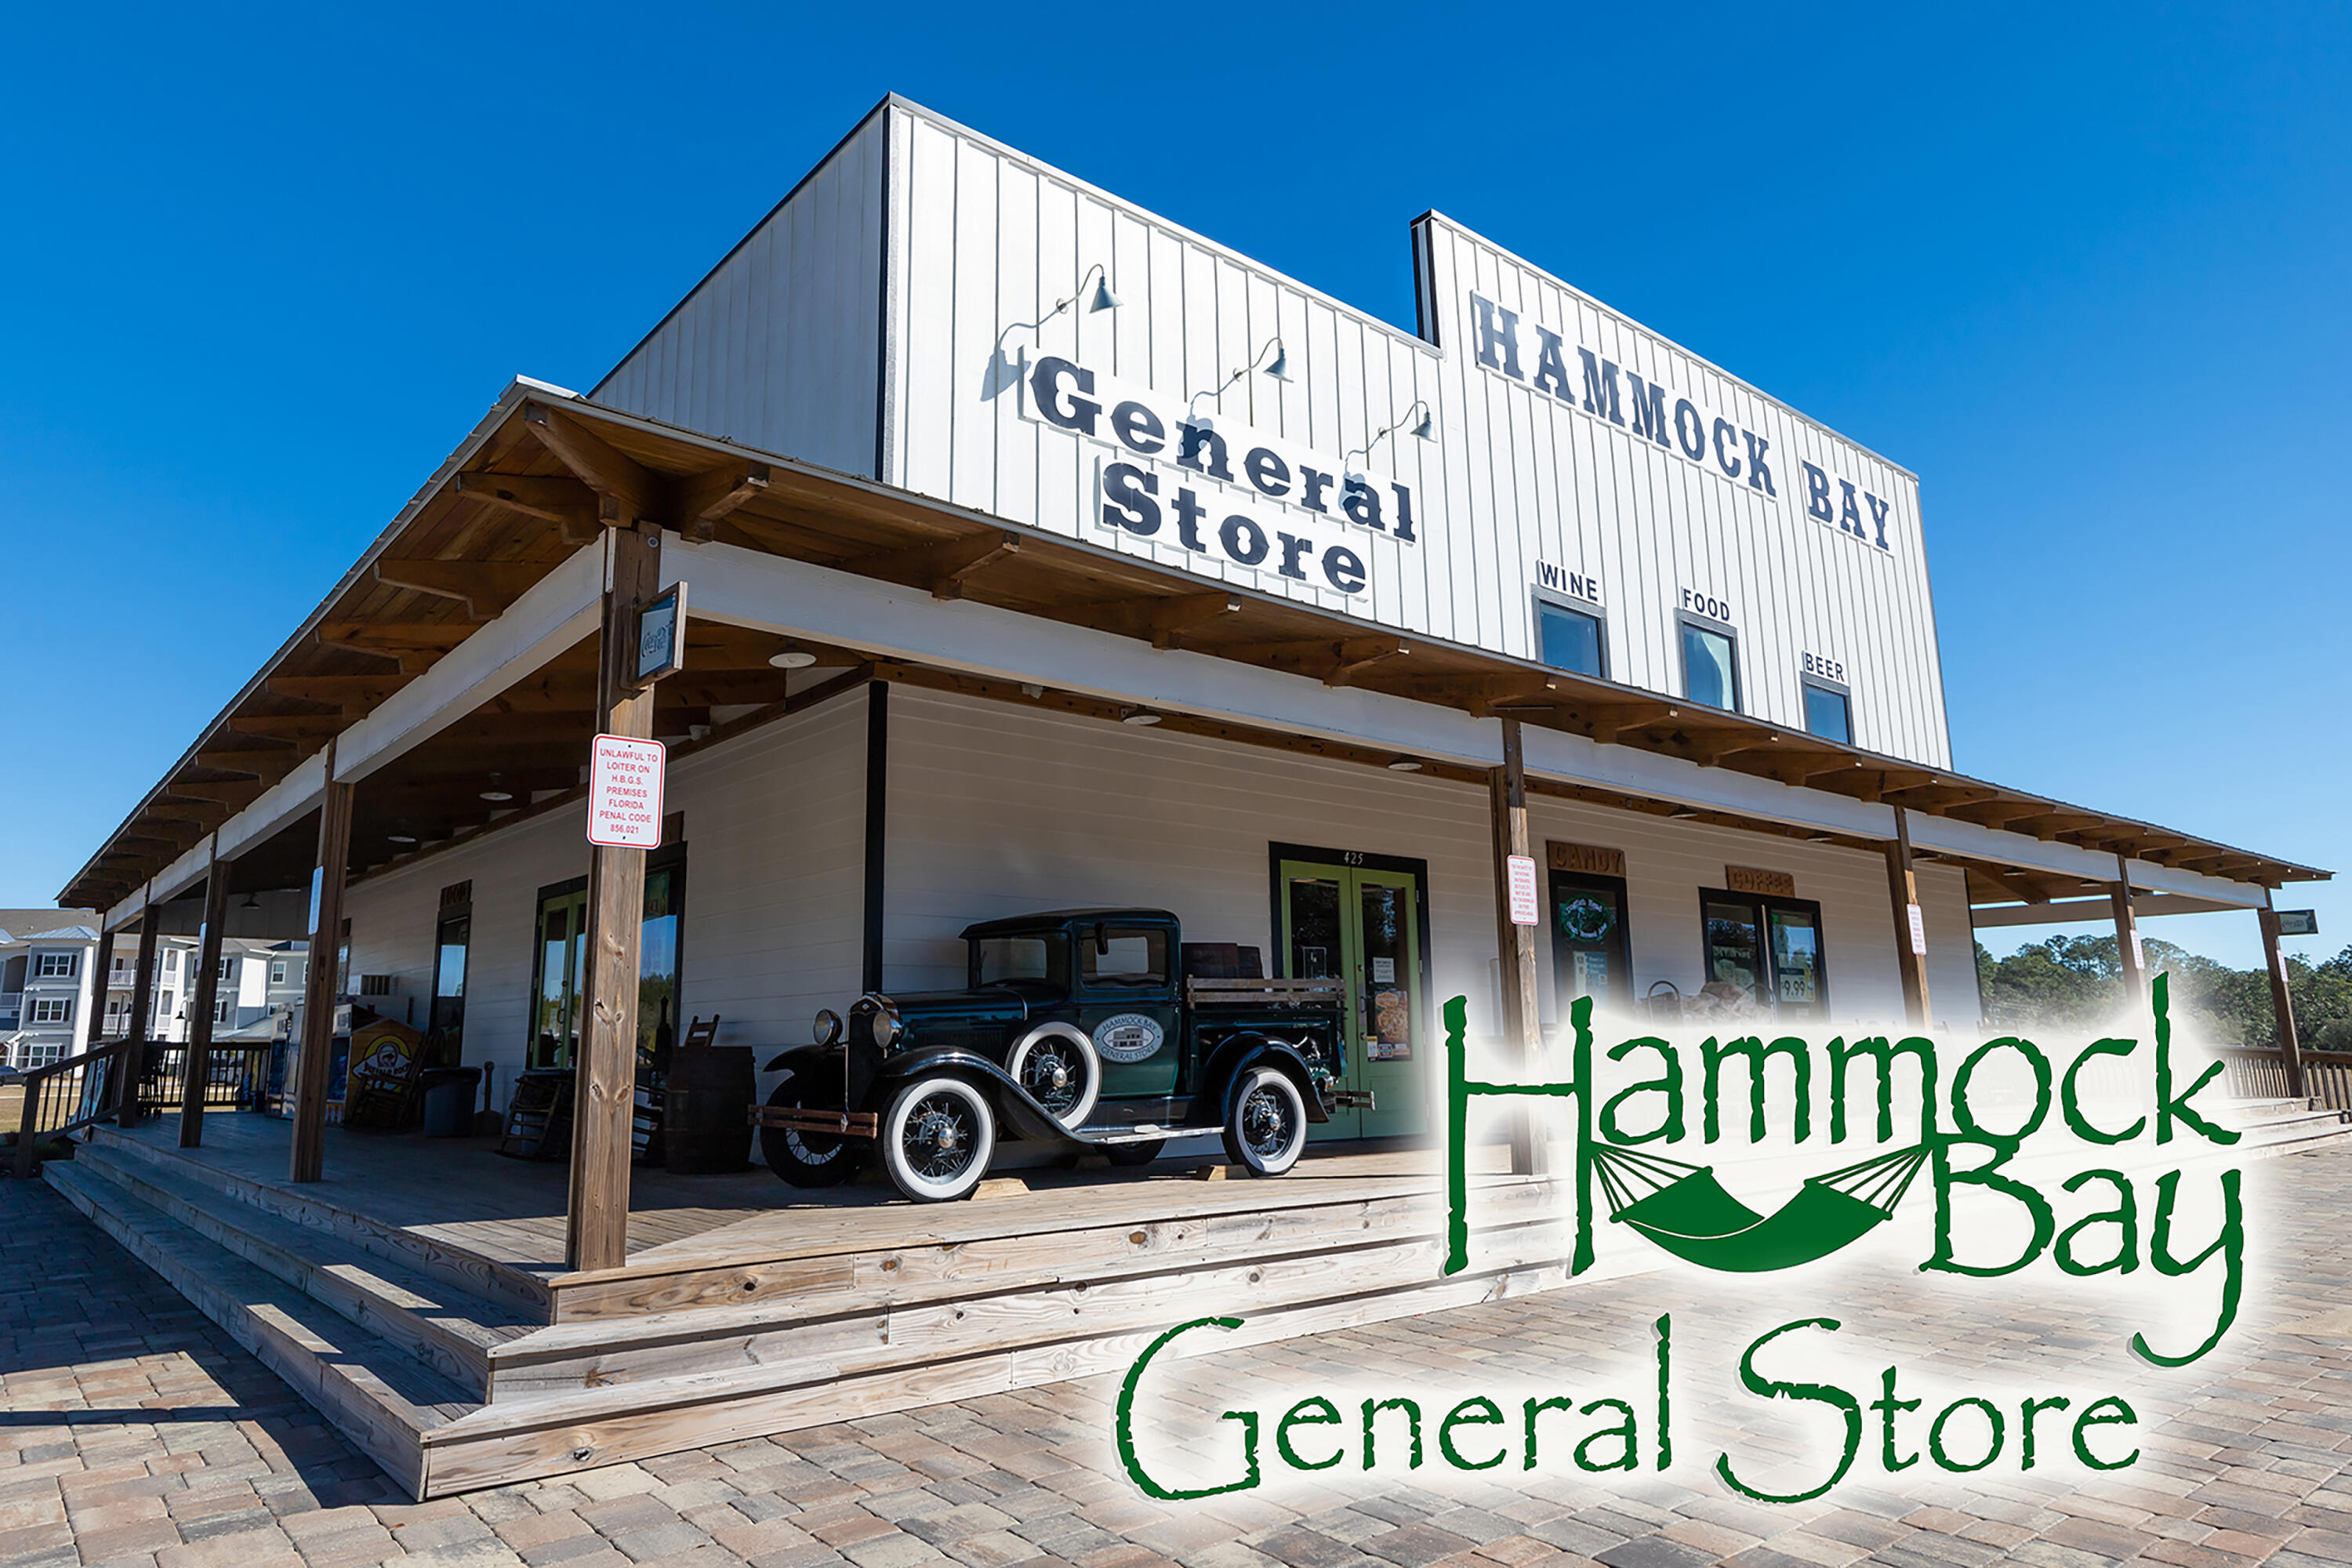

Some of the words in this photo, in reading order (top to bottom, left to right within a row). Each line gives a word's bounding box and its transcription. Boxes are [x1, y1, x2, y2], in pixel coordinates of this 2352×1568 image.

[1475, 294, 1777, 499] HAMMOCK
[1802, 459, 1889, 551] BAY
[1029, 356, 1416, 543] General
[1103, 462, 1367, 593] Store
[1541, 561, 1599, 601] WINE
[1683, 588, 1730, 622] FOOD
[1805, 652, 1845, 682] BEER
[600, 748, 644, 761] UNLAWFUL
[647, 753, 659, 763] TO
[607, 761, 636, 772] LOITER
[637, 764, 650, 774] ON
[606, 786, 648, 798] PREMISES
[608, 798, 644, 810] FLORIDA
[599, 810, 626, 821] PENAL
[628, 812, 652, 823] CODE
[610, 823, 640, 834] 856.021
[1344, 851, 1363, 866] 425
[1556, 844, 1622, 874] CANDY
[1733, 871, 1793, 897] COFFEE
[1101, 1046, 1134, 1060] GENERAL
[1134, 1045, 1155, 1060] STORE
